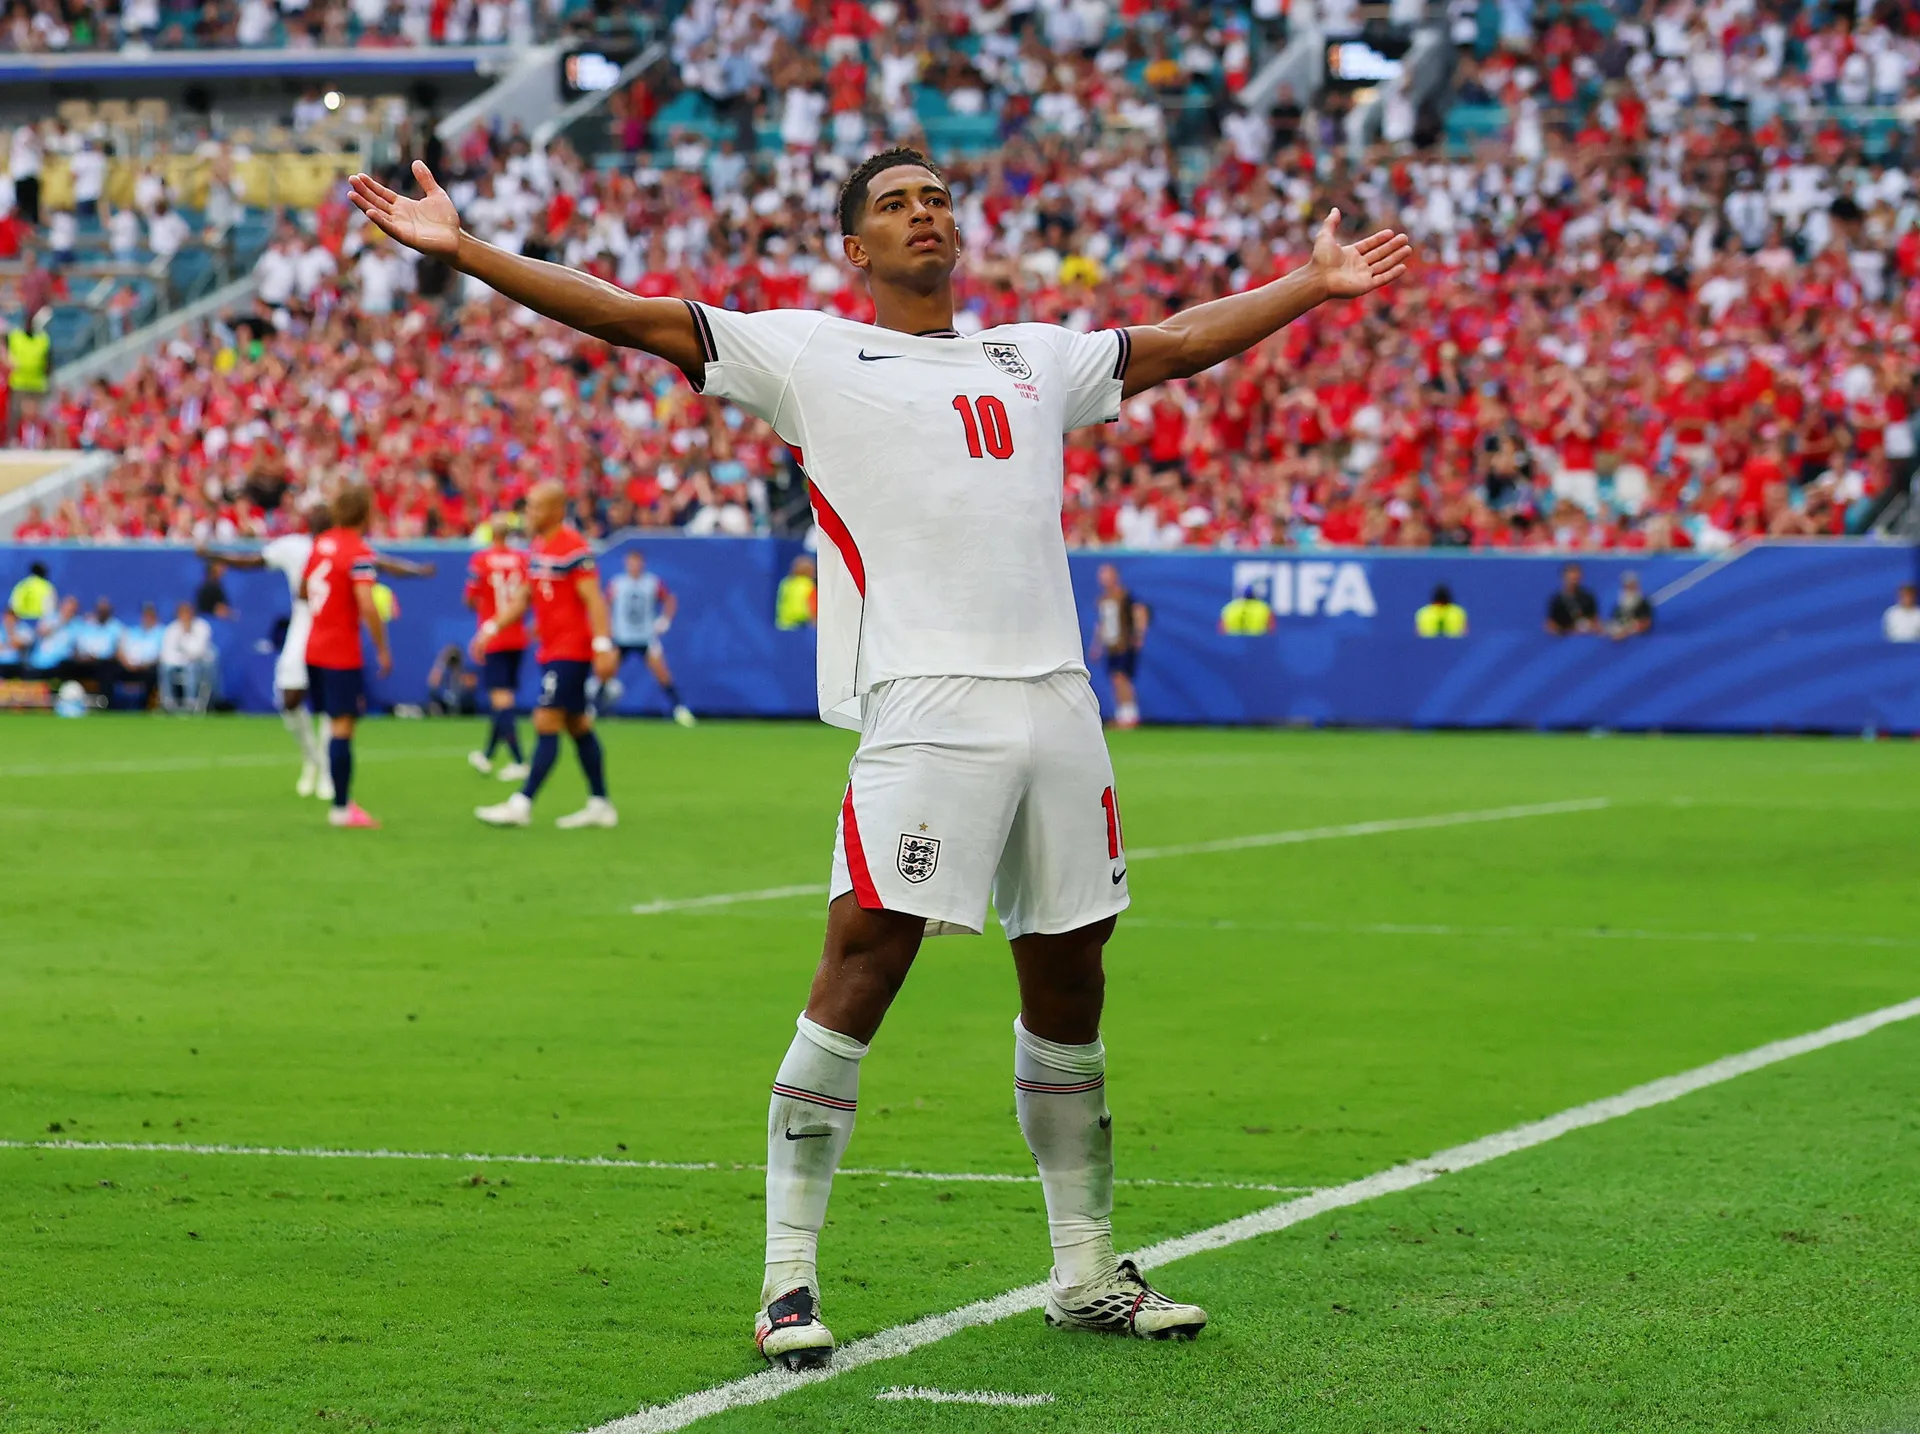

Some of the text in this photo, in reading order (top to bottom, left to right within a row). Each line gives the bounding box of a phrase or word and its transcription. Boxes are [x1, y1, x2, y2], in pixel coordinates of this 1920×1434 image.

[952, 395, 1014, 459] 10
[1233, 560, 1378, 617] FIFA
[1101, 786, 1124, 860] 1
